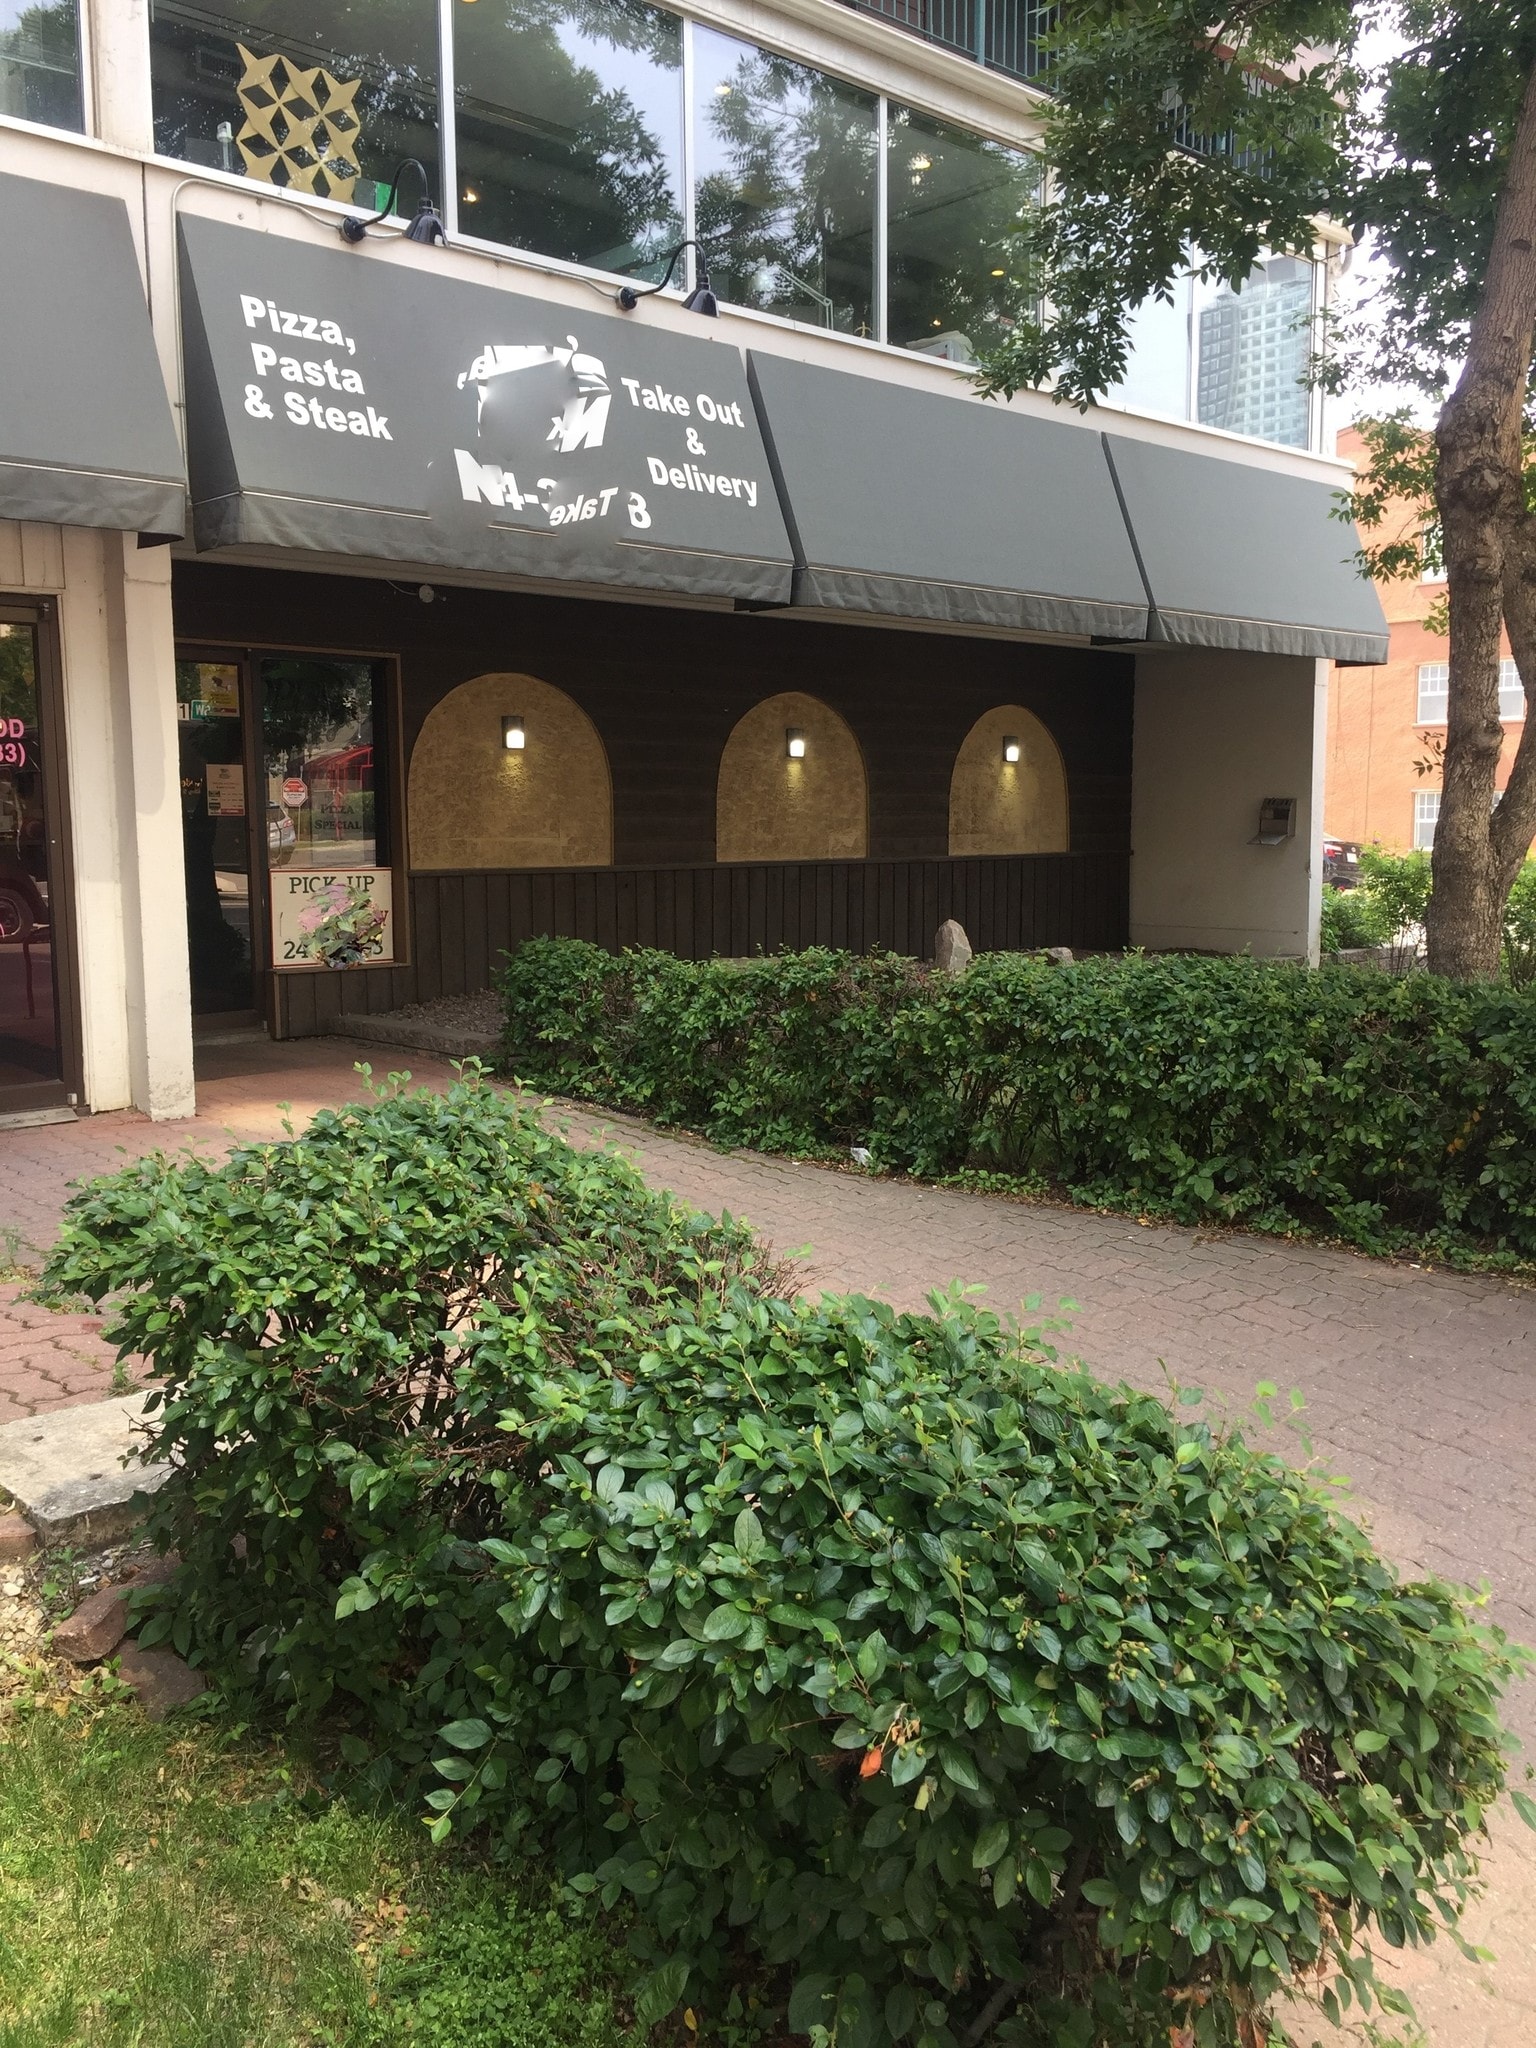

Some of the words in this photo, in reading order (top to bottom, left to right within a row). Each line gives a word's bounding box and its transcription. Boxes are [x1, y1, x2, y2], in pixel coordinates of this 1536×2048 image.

[240, 294, 356, 356] Pizza,
[251, 342, 366, 395] Pasta
[244, 384, 275, 420] &
[284, 391, 394, 441] Steak
[620, 377, 691, 417] Take
[696, 393, 745, 428] Out
[685, 427, 707, 456] &
[646, 456, 757, 507] Delivery
[314, 819, 362, 830] SPECIAL
